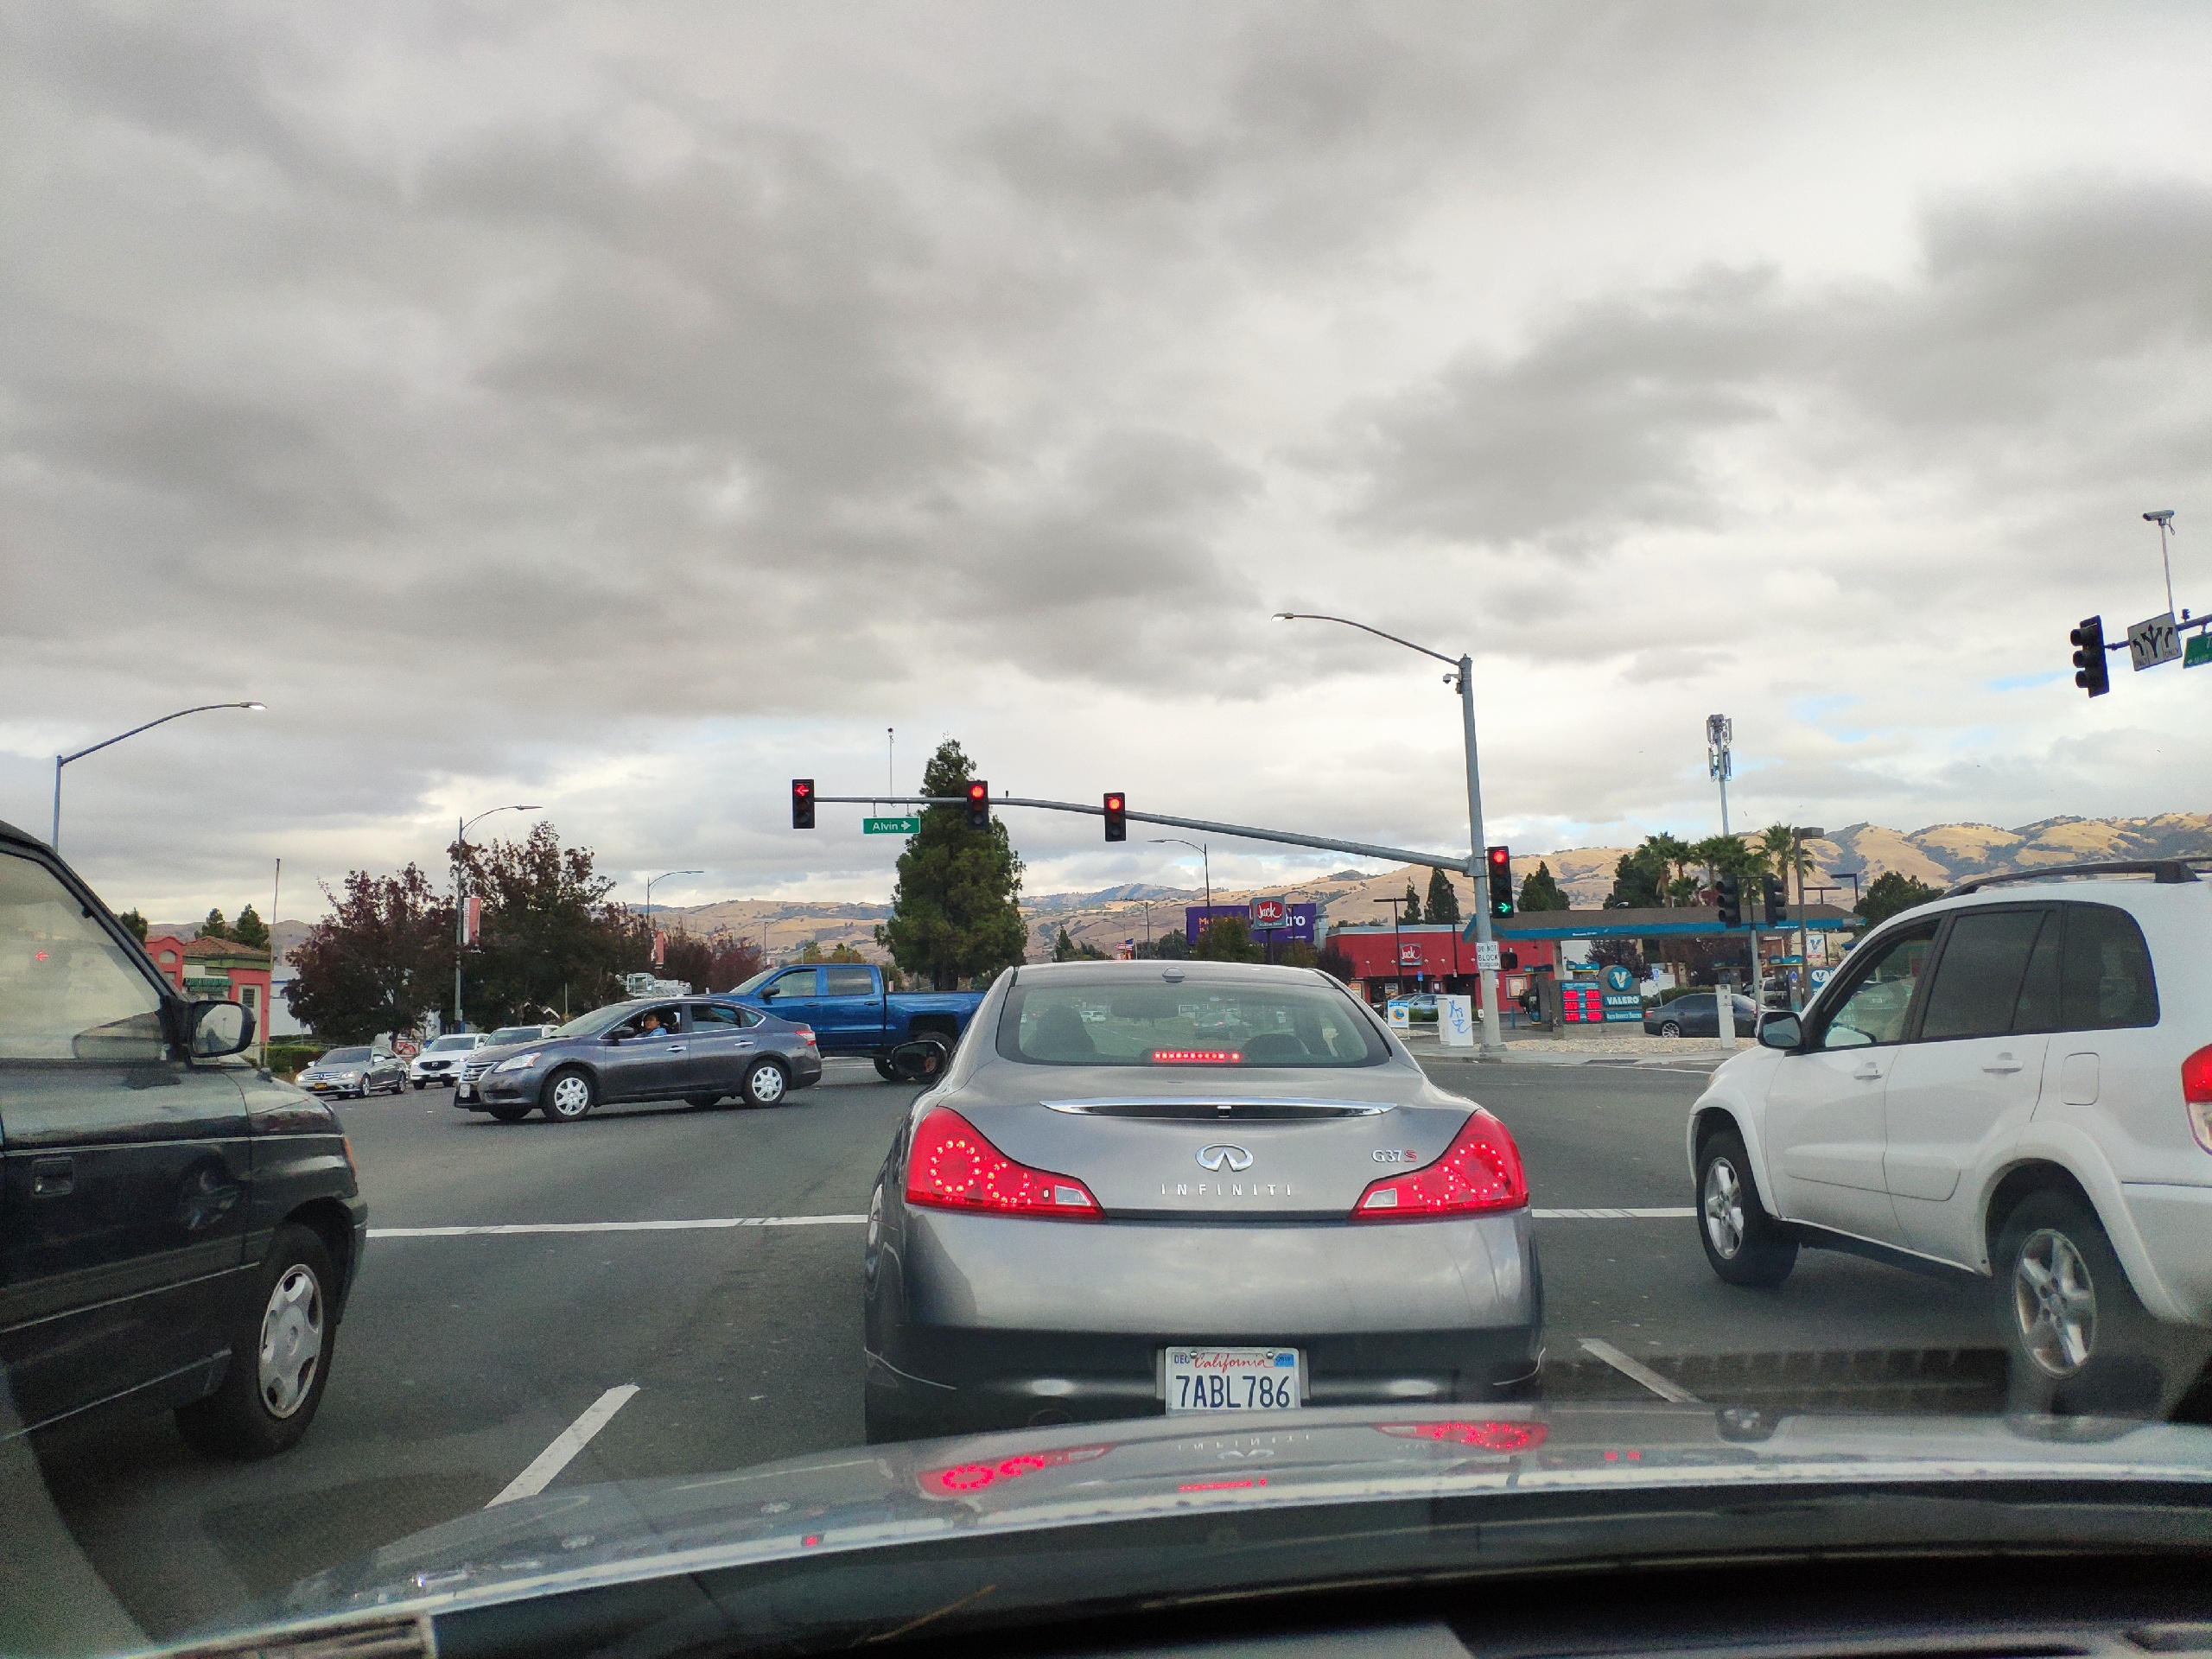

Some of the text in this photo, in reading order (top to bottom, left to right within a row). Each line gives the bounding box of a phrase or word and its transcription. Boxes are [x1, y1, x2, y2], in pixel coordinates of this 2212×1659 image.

[873, 822, 899, 831] Alvin
[1257, 902, 1281, 918] Jack
[1401, 945, 1421, 960] Jack
[1607, 995, 1639, 1005] VALERO
[1160, 1183, 1292, 1196] INFINITI
[1194, 1353, 1274, 1374] California
[1175, 1375, 1290, 1408] 7ABL786
